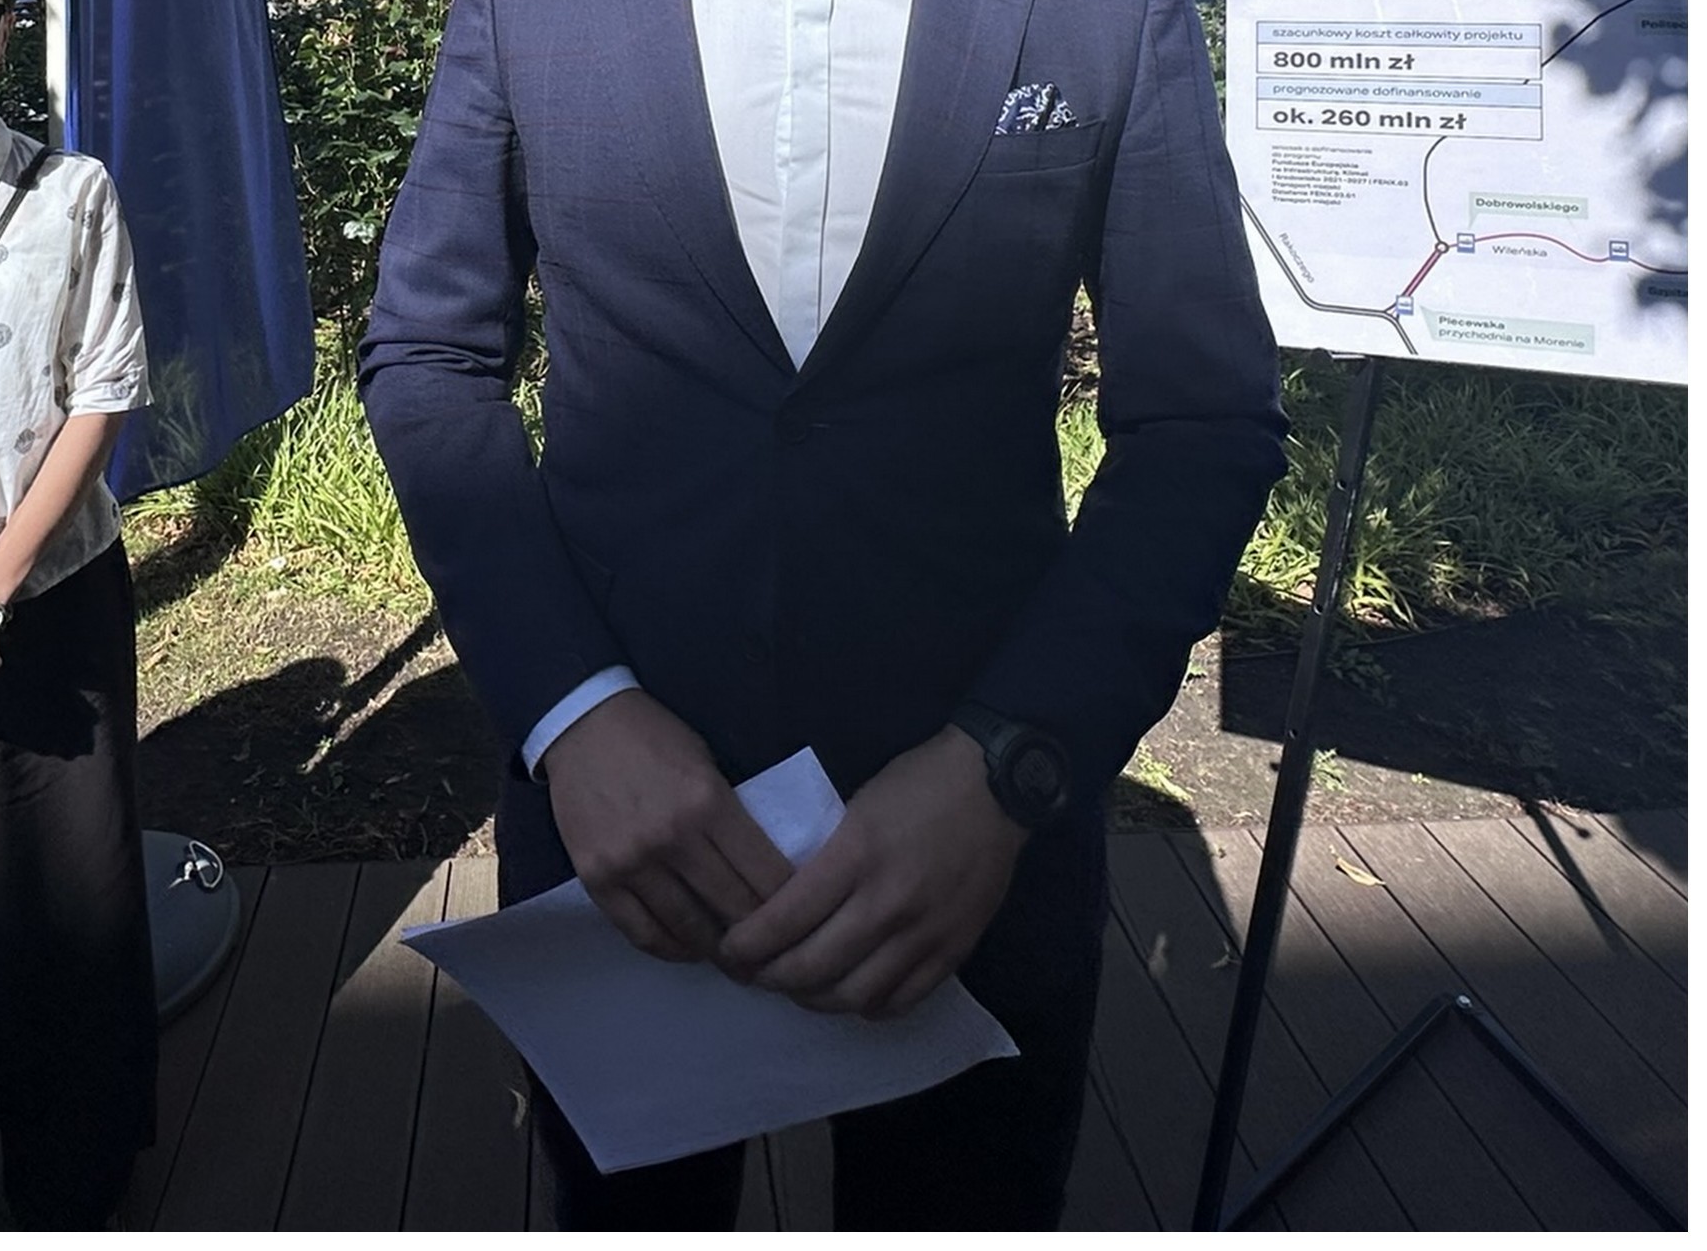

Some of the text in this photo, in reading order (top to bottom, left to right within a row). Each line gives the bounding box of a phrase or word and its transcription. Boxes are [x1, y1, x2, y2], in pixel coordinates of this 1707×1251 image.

[1272, 28, 1523, 42] szacunkowy koszt całkowity projektu
[1273, 51, 1415, 70] 800 mln zł
[1273, 85, 1482, 99] prognozowane dofinansowanie
[1273, 108, 1467, 130] ok. 260 mln zł
[1476, 198, 1580, 213] Dobrowolskiego
[1492, 245, 1548, 258] Wileńska
[1439, 316, 1505, 330] Piecewska
[1439, 328, 1585, 349] przychodnia na Morenie
